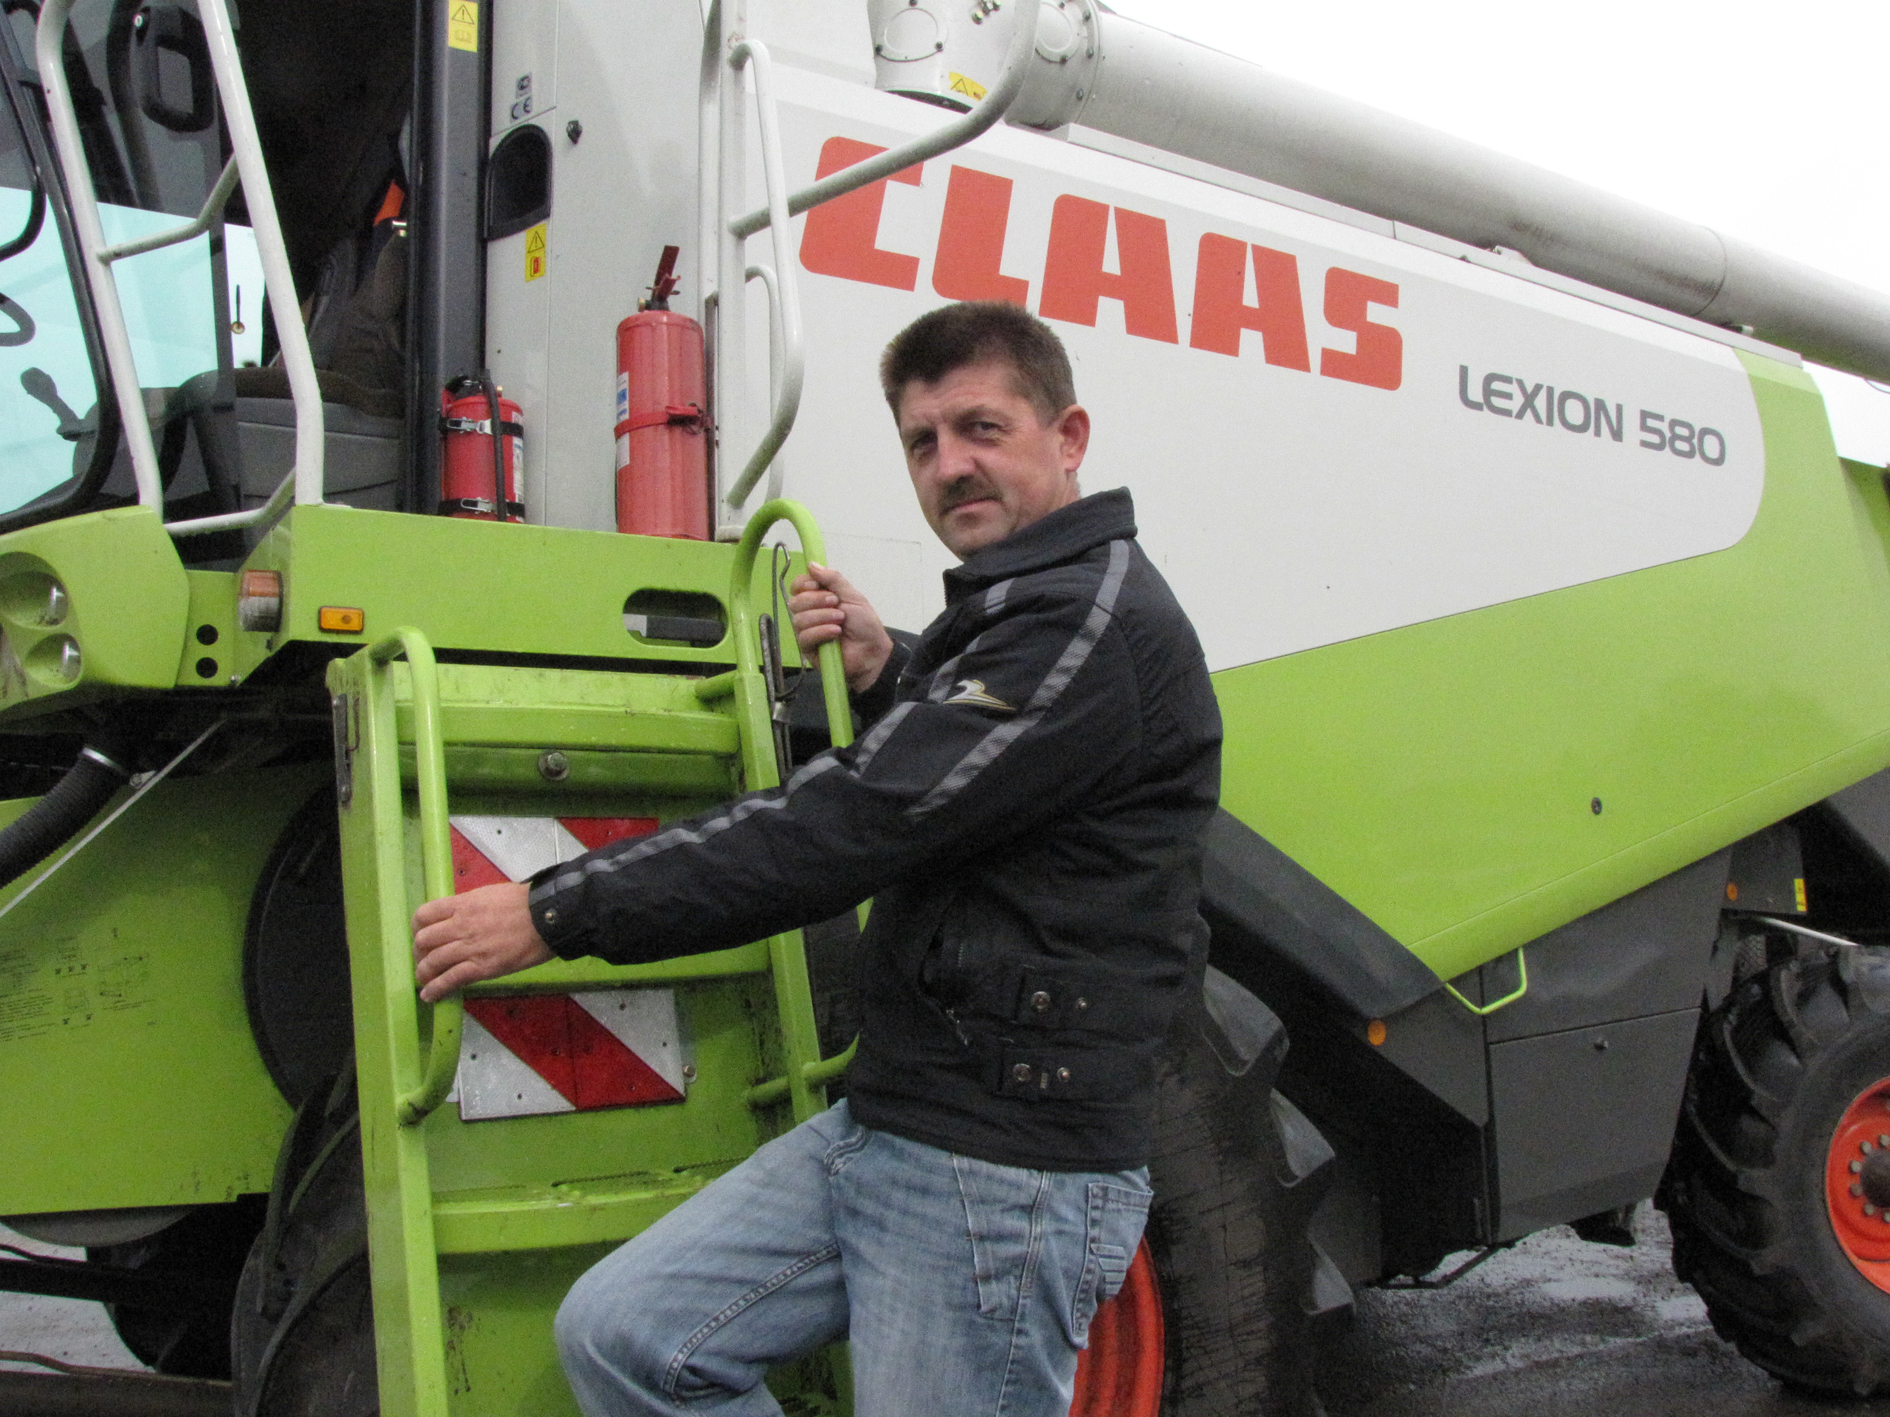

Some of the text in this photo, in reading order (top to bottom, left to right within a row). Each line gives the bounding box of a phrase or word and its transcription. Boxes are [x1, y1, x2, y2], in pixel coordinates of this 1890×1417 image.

[800, 136, 1403, 391] CLAAS
[1458, 364, 1726, 467] LEXION 580
